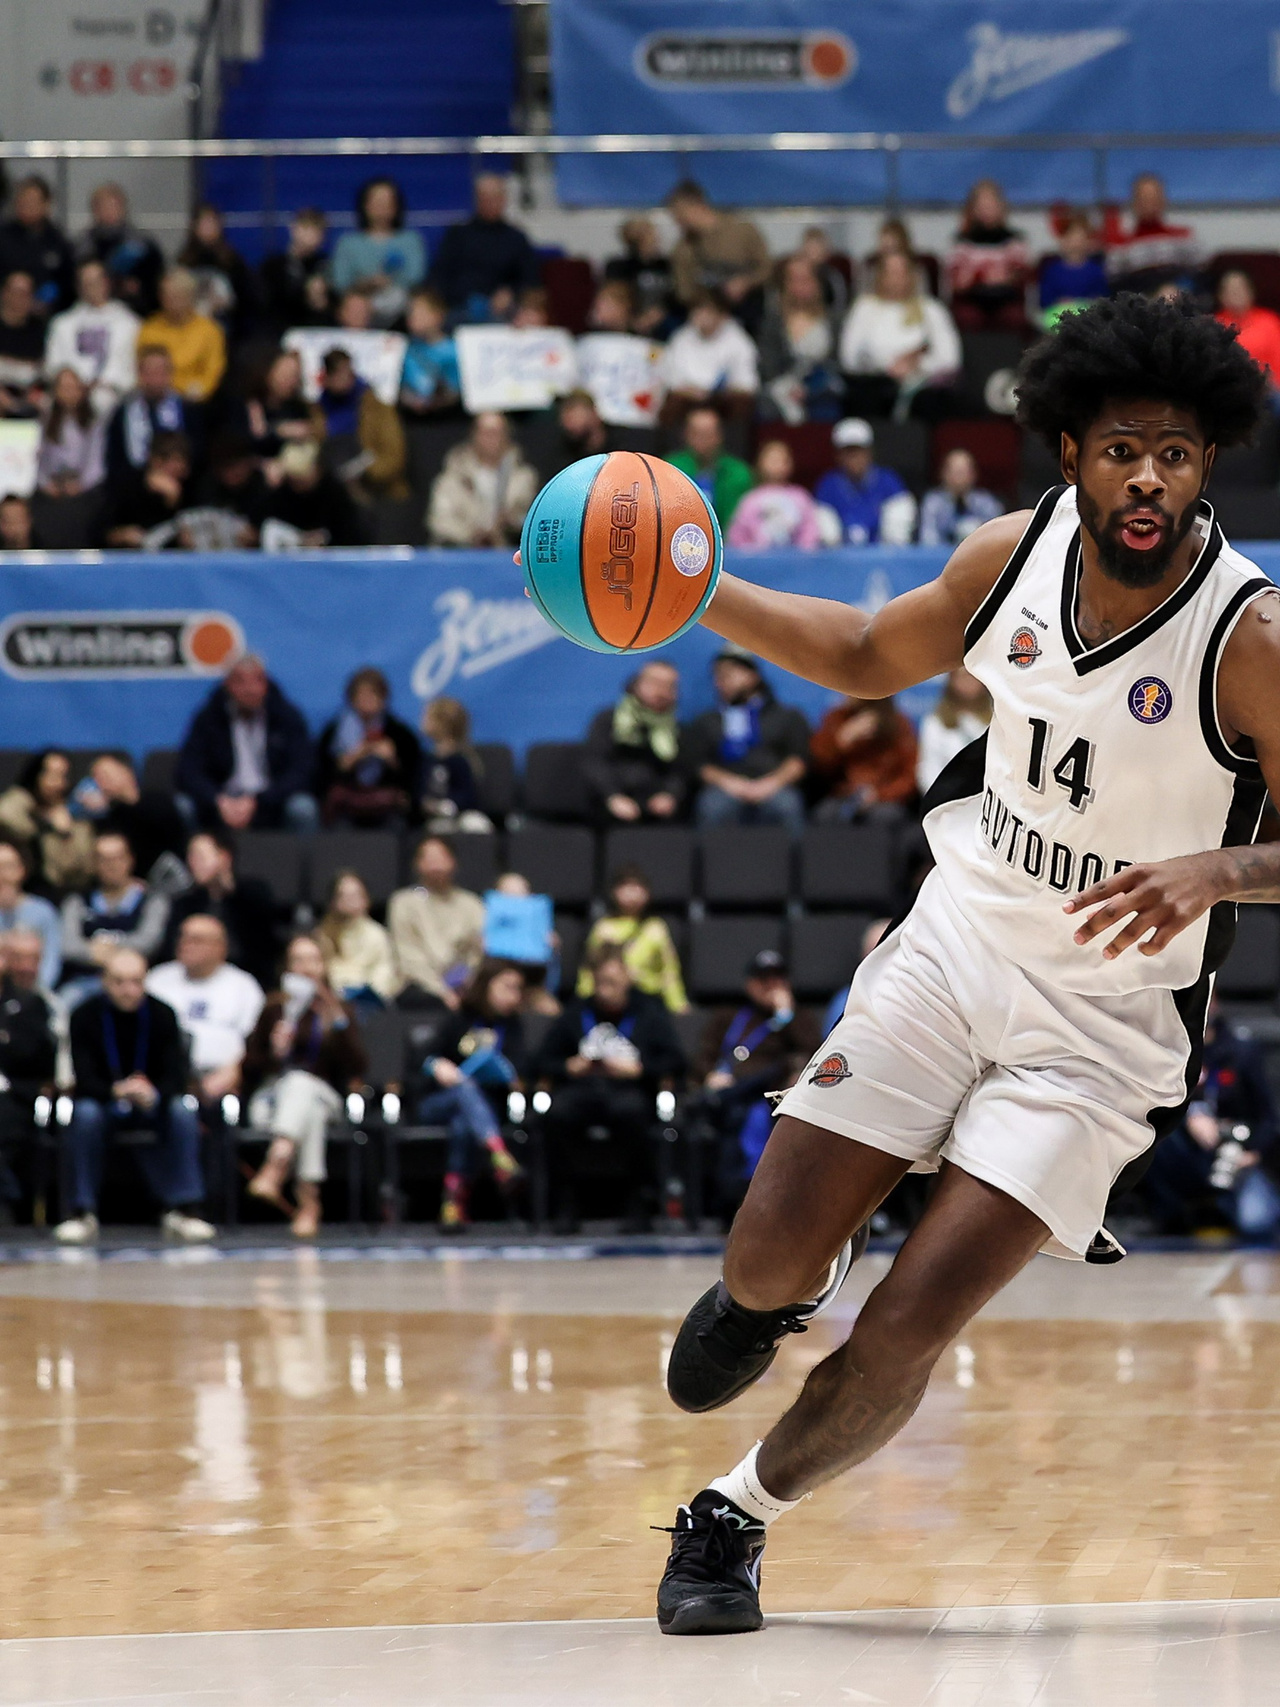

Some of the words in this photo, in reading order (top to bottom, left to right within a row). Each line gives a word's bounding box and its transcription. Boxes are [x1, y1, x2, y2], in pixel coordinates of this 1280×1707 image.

[15, 625, 174, 666] Winline
[1026, 716, 1095, 811] 14
[980, 784, 1136, 894] AVTODO
